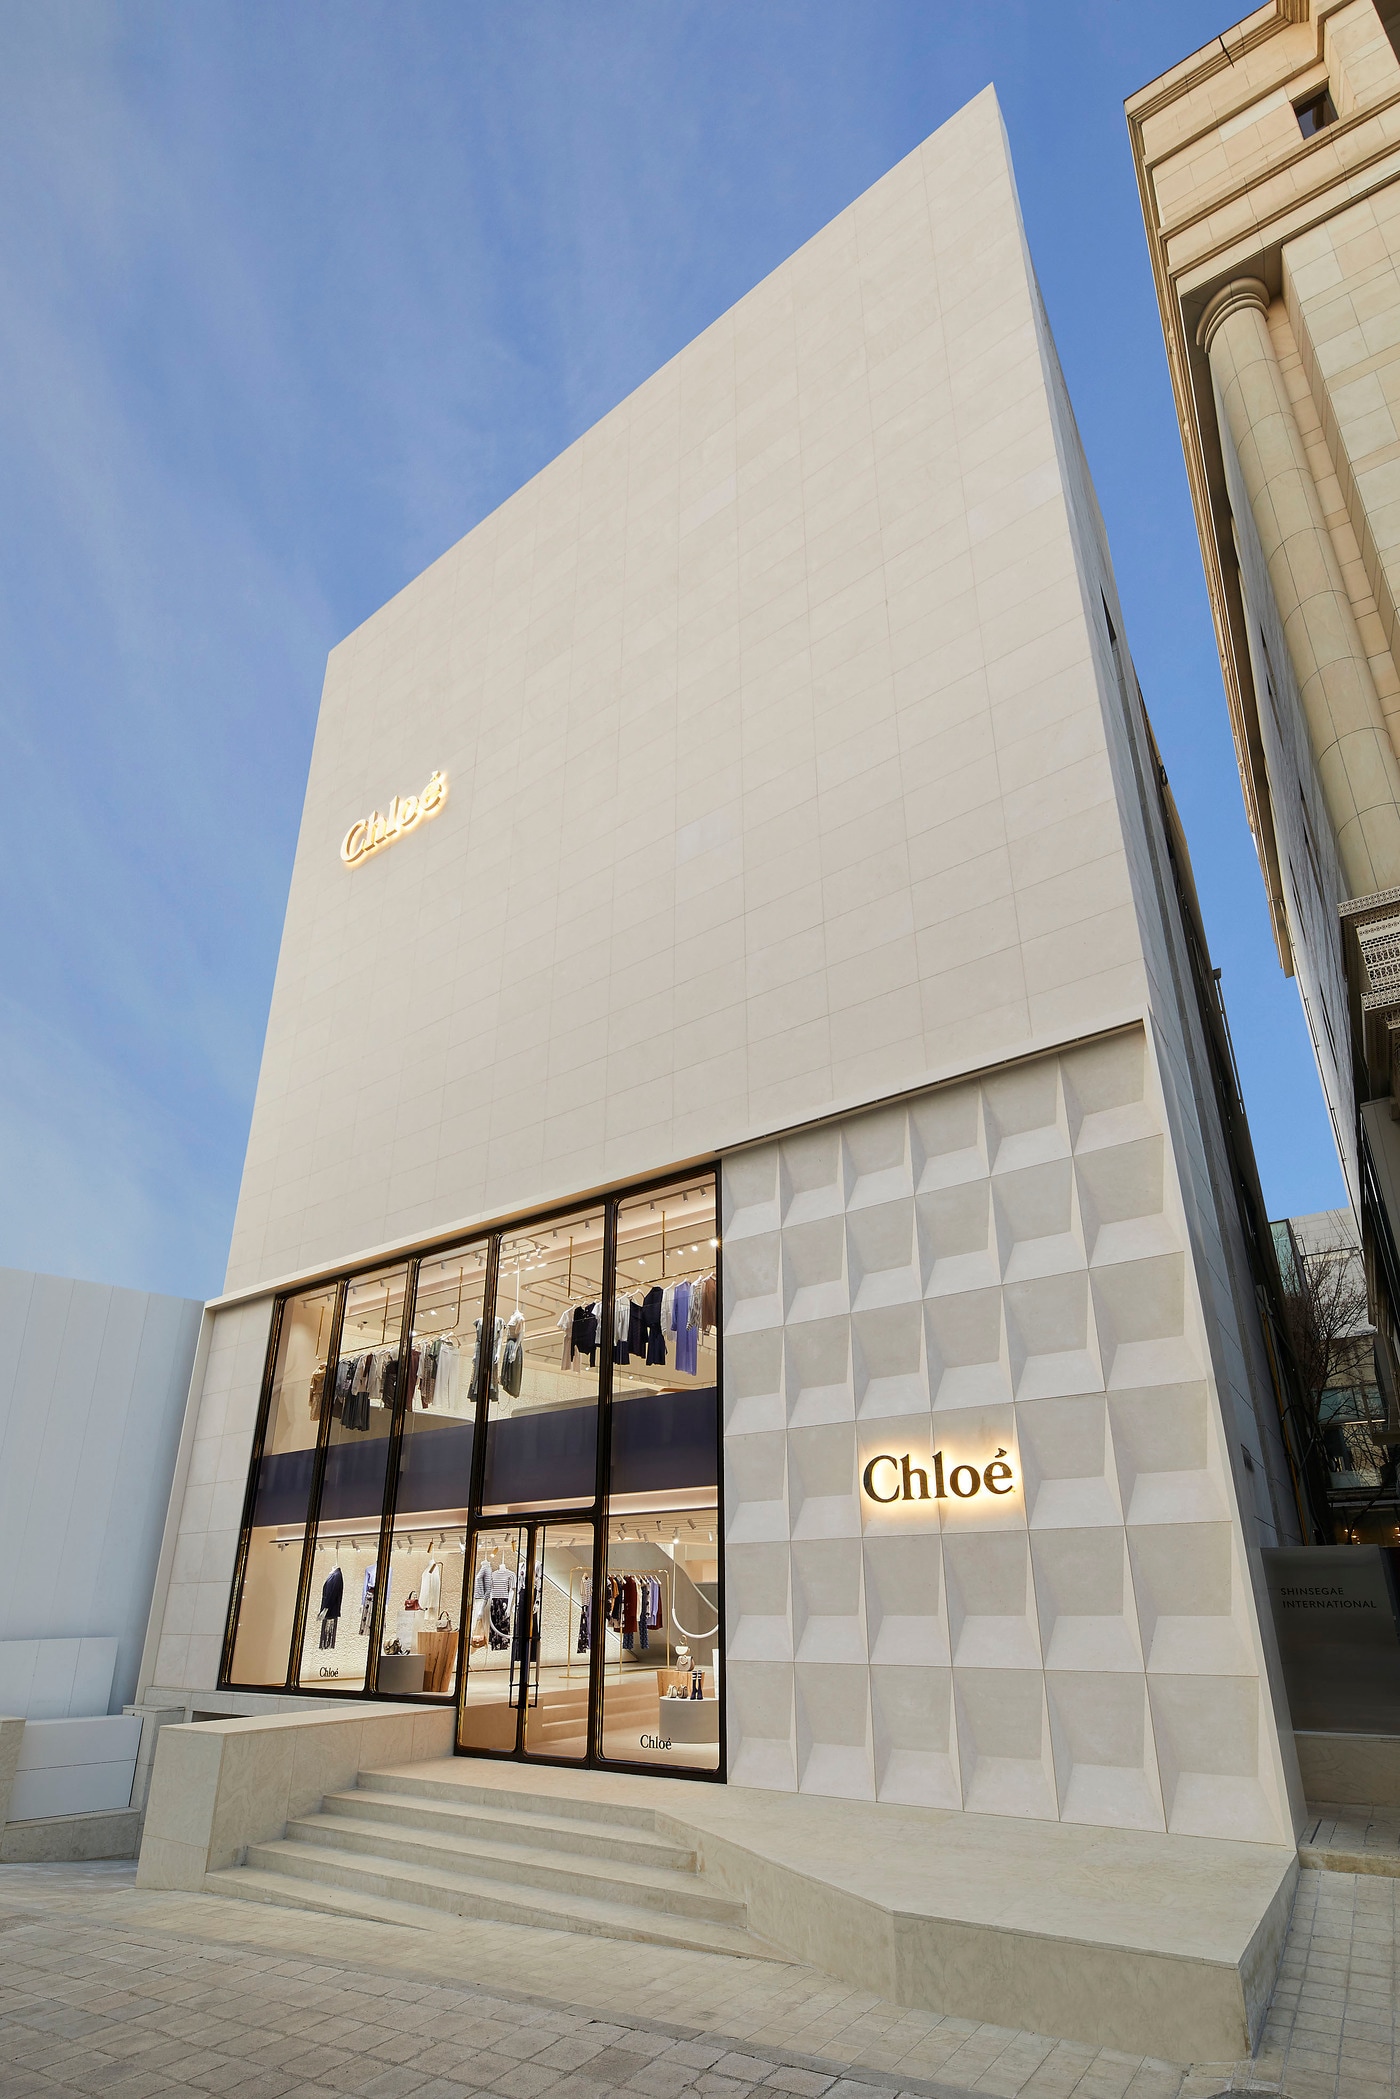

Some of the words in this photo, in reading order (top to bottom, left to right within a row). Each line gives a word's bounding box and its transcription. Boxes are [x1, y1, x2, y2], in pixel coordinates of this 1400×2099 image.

[340, 770, 442, 863] Chloé
[863, 1448, 1014, 1503] Chloé
[1280, 1588, 1344, 1596] SHINSEGAE
[1282, 1600, 1377, 1609] INTERNATIONAL
[319, 1666, 339, 1678] Chloé
[640, 1734, 672, 1750] Chloé
